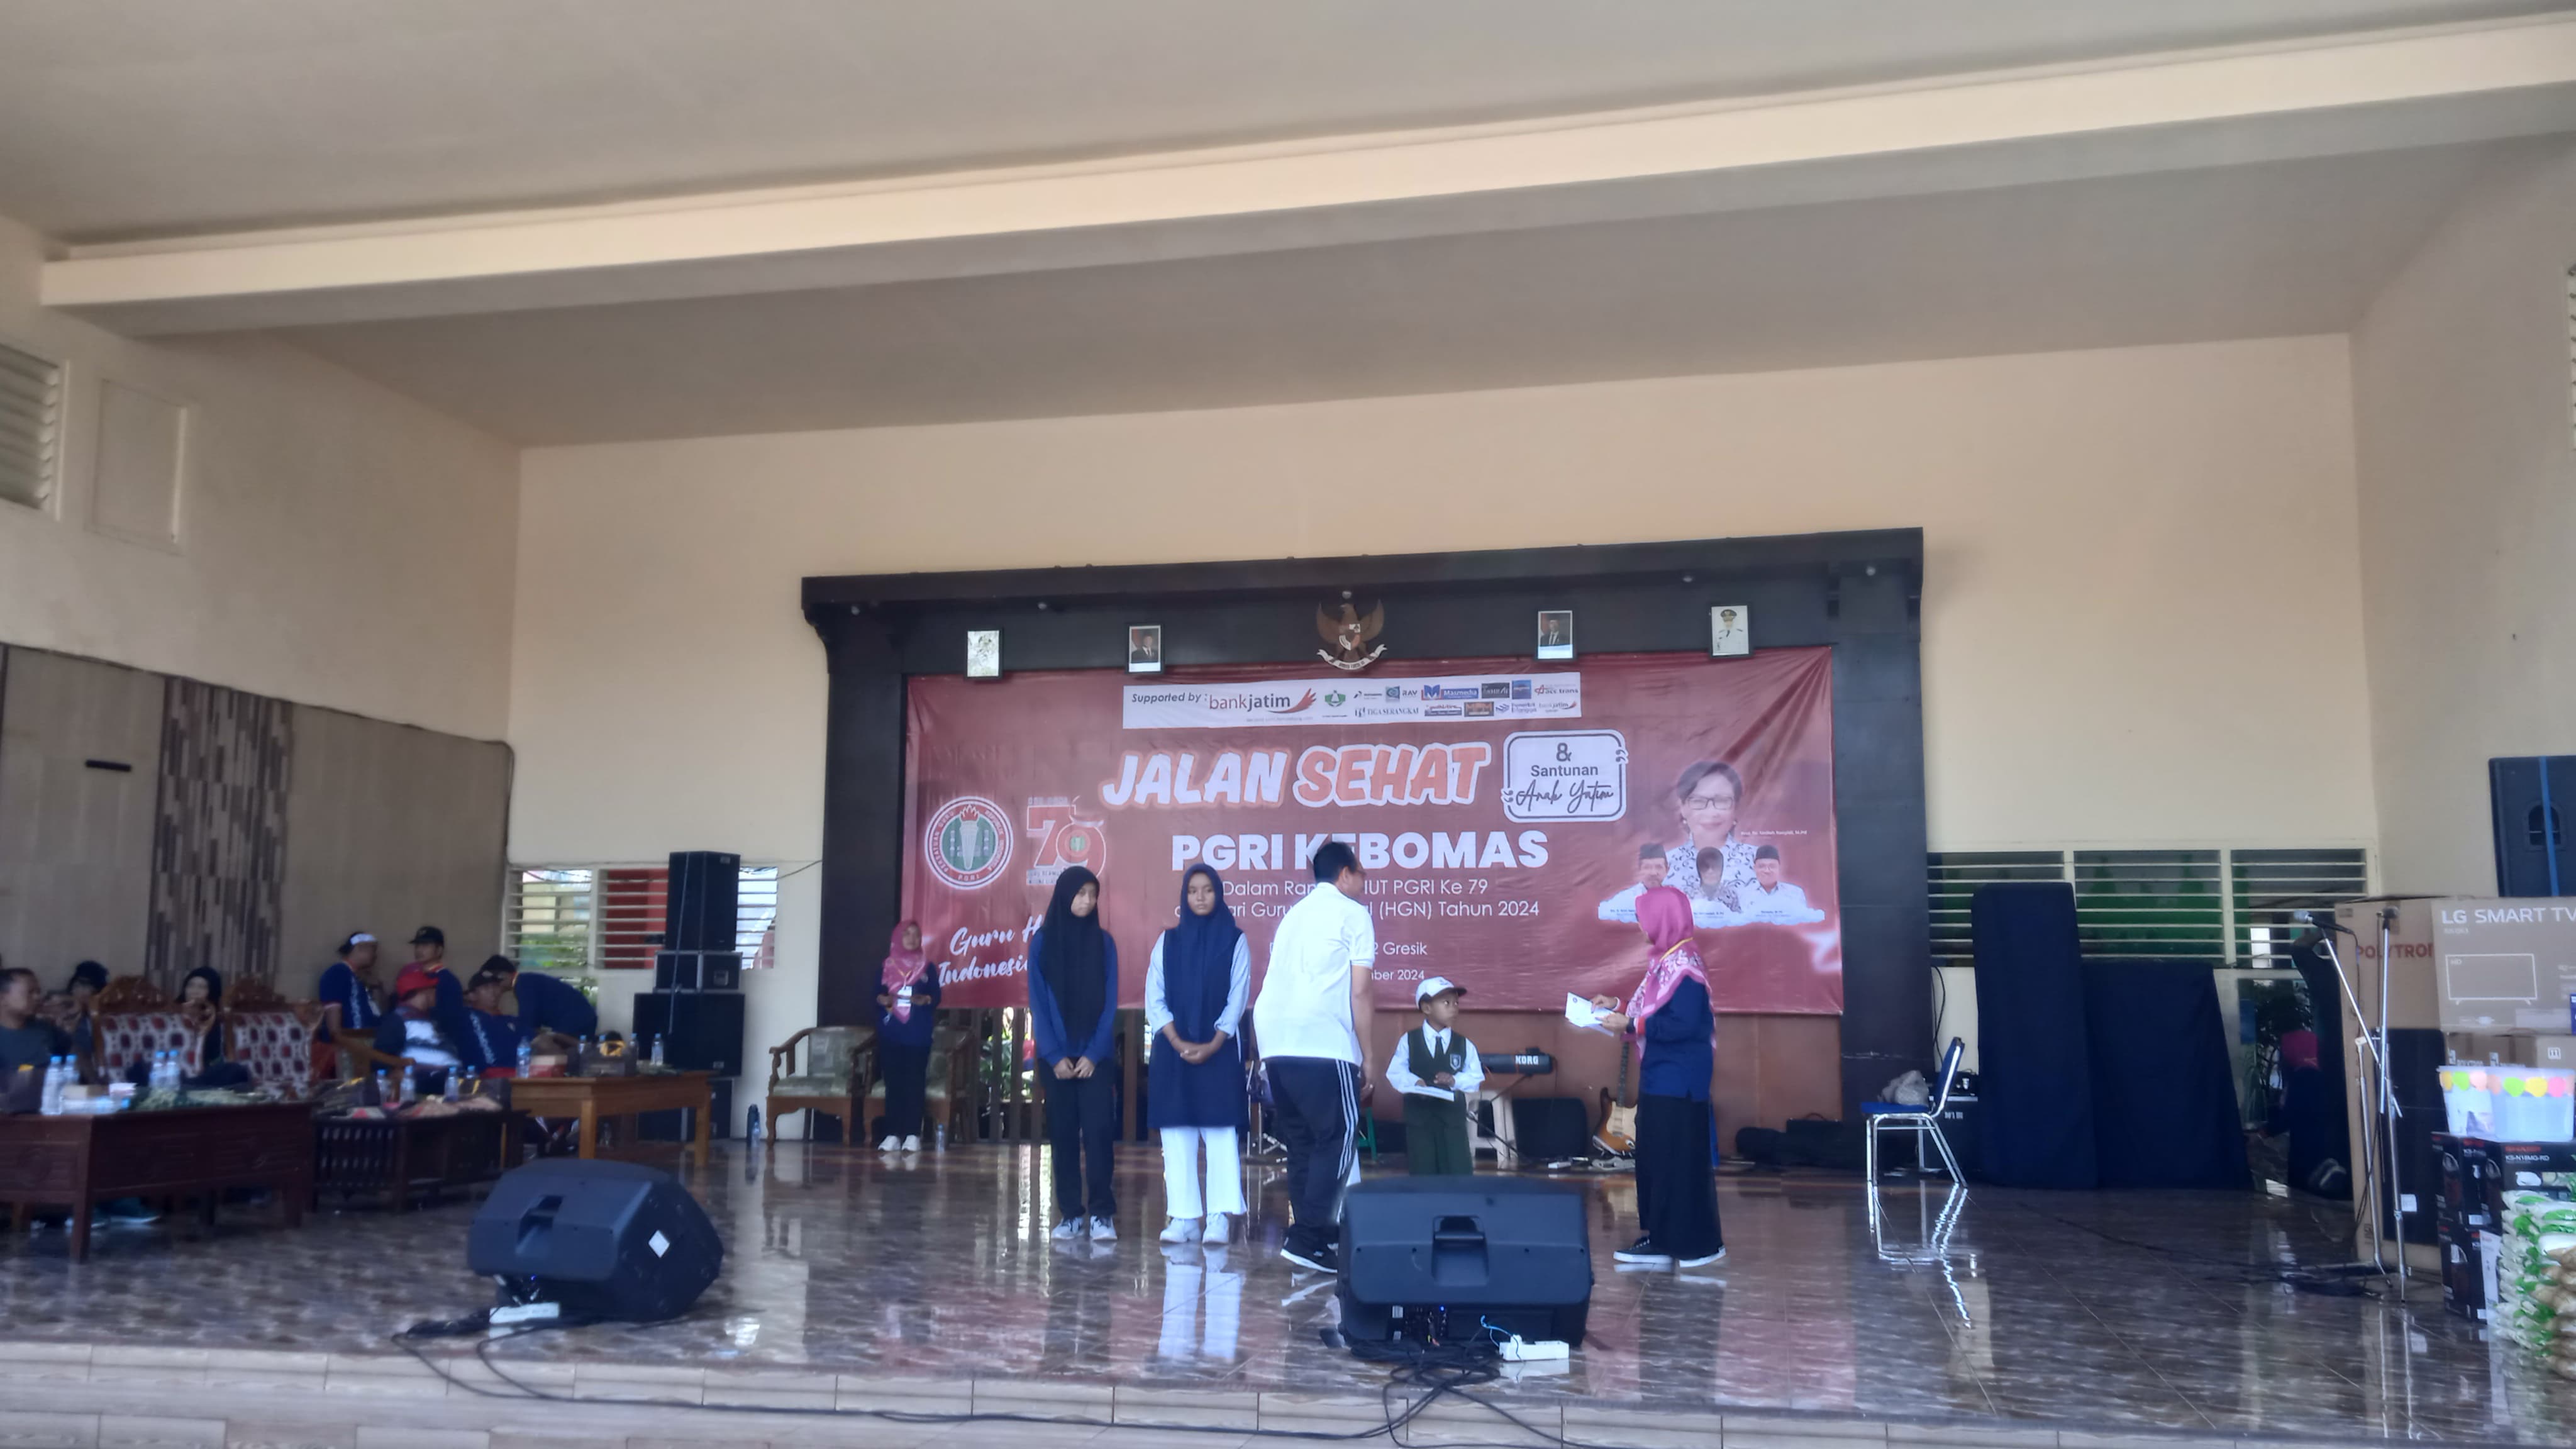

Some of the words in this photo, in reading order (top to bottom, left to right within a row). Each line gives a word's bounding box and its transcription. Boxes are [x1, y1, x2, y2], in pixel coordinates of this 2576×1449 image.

[1132, 692, 1185, 704] Supported
[1188, 692, 1202, 702] by
[1209, 694, 1291, 711] bankjatim
[1556, 742, 1572, 762] &
[1102, 751, 1289, 806] JALAN
[1294, 743, 1491, 806] SEHAT
[1530, 765, 1599, 777] Santunan
[1516, 779, 1563, 812] Anak
[1172, 833, 1284, 871] PGRI
[1223, 880, 1279, 896] Dalam
[1393, 880, 1435, 895] PGRI
[1440, 879, 1463, 894] Ke
[1468, 879, 1488, 894] 79
[1230, 902, 1246, 918] ari
[1251, 901, 1291, 918] Guru
[1379, 901, 1433, 920] (HGN)
[1438, 901, 1492, 916] Tahun
[1498, 901, 1540, 916] 2024
[2441, 909, 2468, 924] LG
[2474, 907, 2546, 924] SMART
[949, 926, 1016, 957] Guru
[1383, 941, 1428, 955] Gresik
[938, 954, 1028, 988] Indonesi
[1397, 969, 1424, 980] 2024
[1515, 1055, 1539, 1065] KORG
